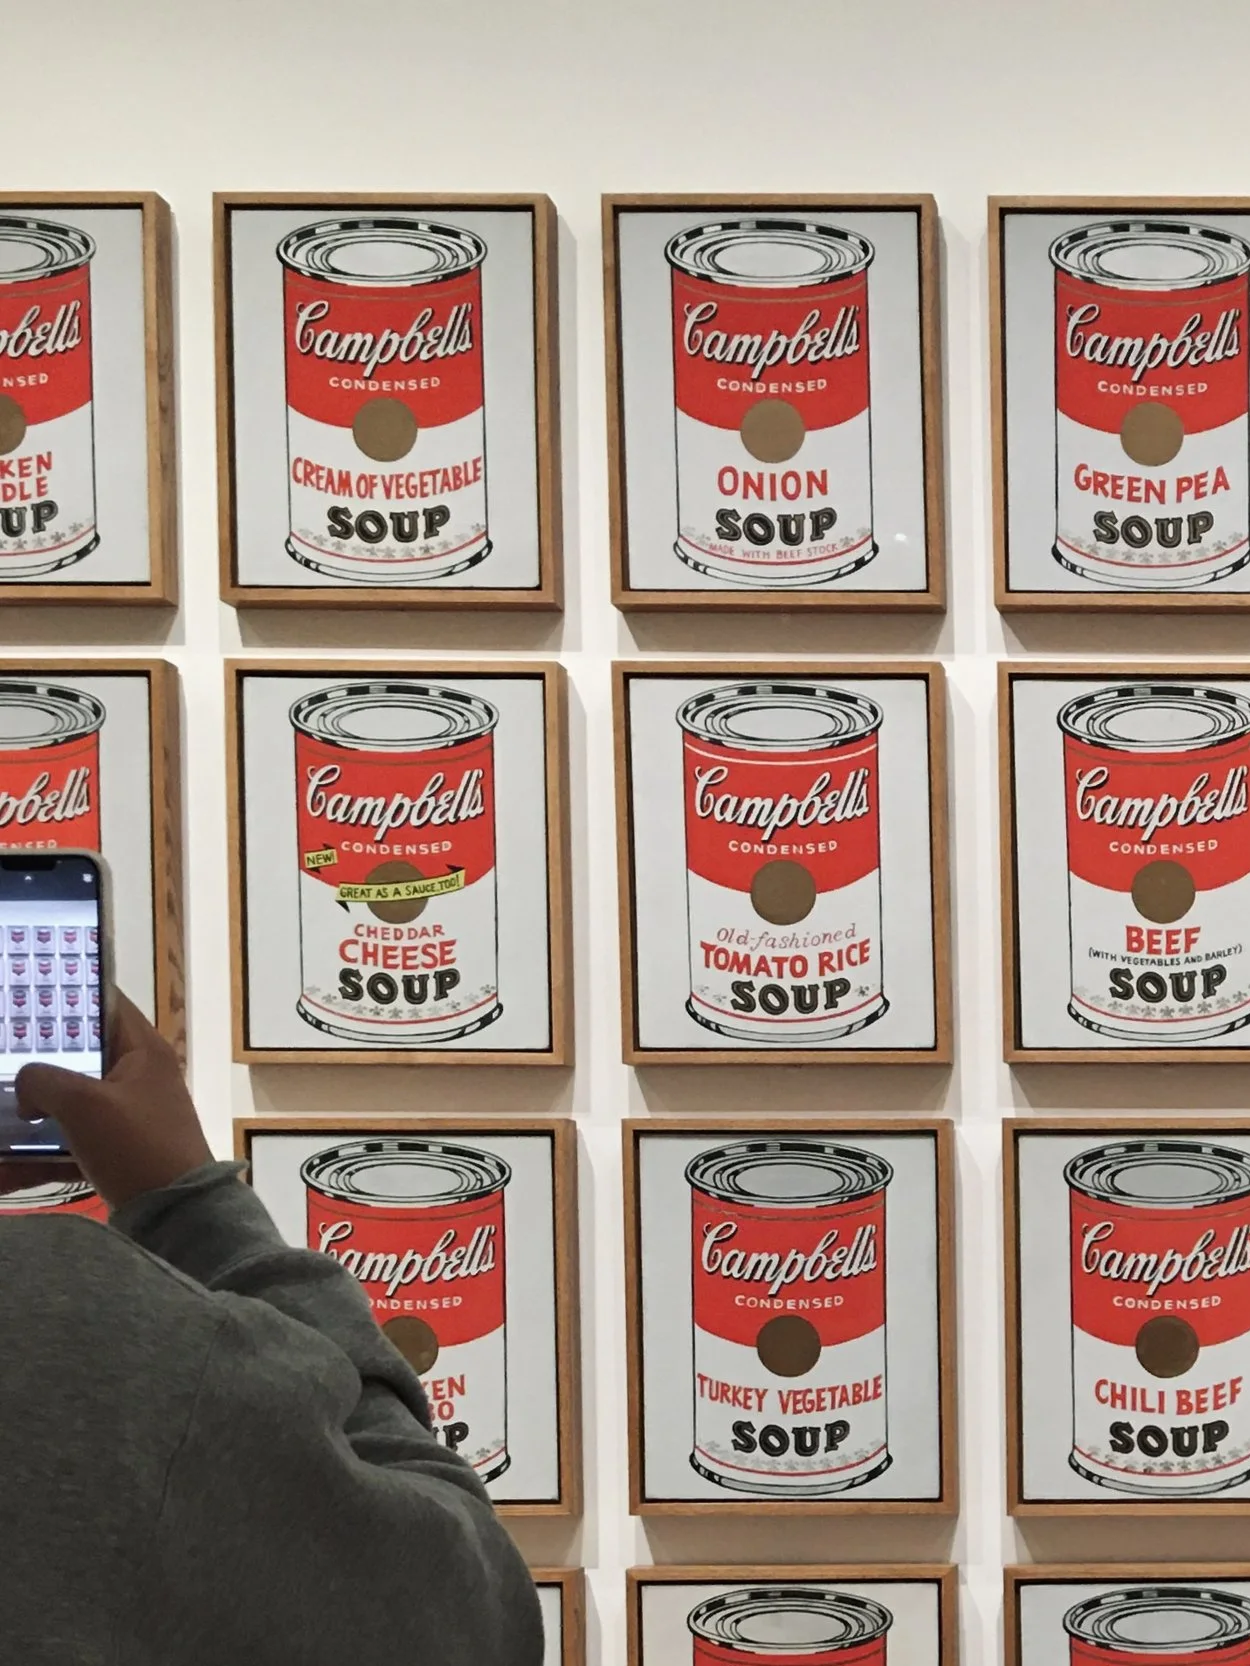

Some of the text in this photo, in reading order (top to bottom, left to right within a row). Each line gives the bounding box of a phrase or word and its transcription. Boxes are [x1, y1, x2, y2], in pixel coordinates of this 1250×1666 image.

[0, 301, 81, 357] bell's
[329, 377, 439, 391] CONDENSED
[717, 378, 826, 393] CONDENSED
[1098, 381, 1207, 396] CONDENSED
[0, 477, 46, 501] DLE
[292, 458, 480, 499] CREAM OF VEGETABLE
[718, 466, 827, 501] ONION
[1074, 464, 1229, 503] GREEN PEA
[0, 501, 58, 537] UP
[327, 505, 450, 543] SOUP
[716, 508, 837, 546] SOUP
[1093, 511, 1213, 548] SOUP
[709, 544, 837, 559] MADE WITH BEEF STOCK
[306, 854, 335, 866] NEW!
[341, 841, 451, 855] CONDENSED
[729, 840, 836, 855] CONDENSED
[1109, 840, 1217, 854] CONDENSED
[340, 887, 372, 898] GREAT
[376, 888, 388, 898] AS
[393, 885, 401, 896] A
[355, 924, 443, 940] CHEDDAR
[717, 923, 856, 951] Old-fashioned
[1126, 926, 1200, 955] BEEF
[339, 939, 456, 970] CHEESE
[701, 940, 869, 978] TOMATO RICE
[1089, 944, 1242, 966] (WITH VEGETABLES AND BARLEY)
[339, 968, 460, 1004] SOUP
[731, 978, 850, 1015] SOUP
[1109, 964, 1226, 1003] SOUP
[369, 1296, 463, 1310] NDENSED
[736, 1296, 842, 1309] CONDENSED
[1113, 1296, 1220, 1309] CONDENSED
[698, 1375, 881, 1414] TURKEY VEGETABLE
[1095, 1378, 1241, 1416] CHILI BEEF
[731, 1420, 850, 1457] SOUP
[1109, 1420, 1229, 1457] SOUP
